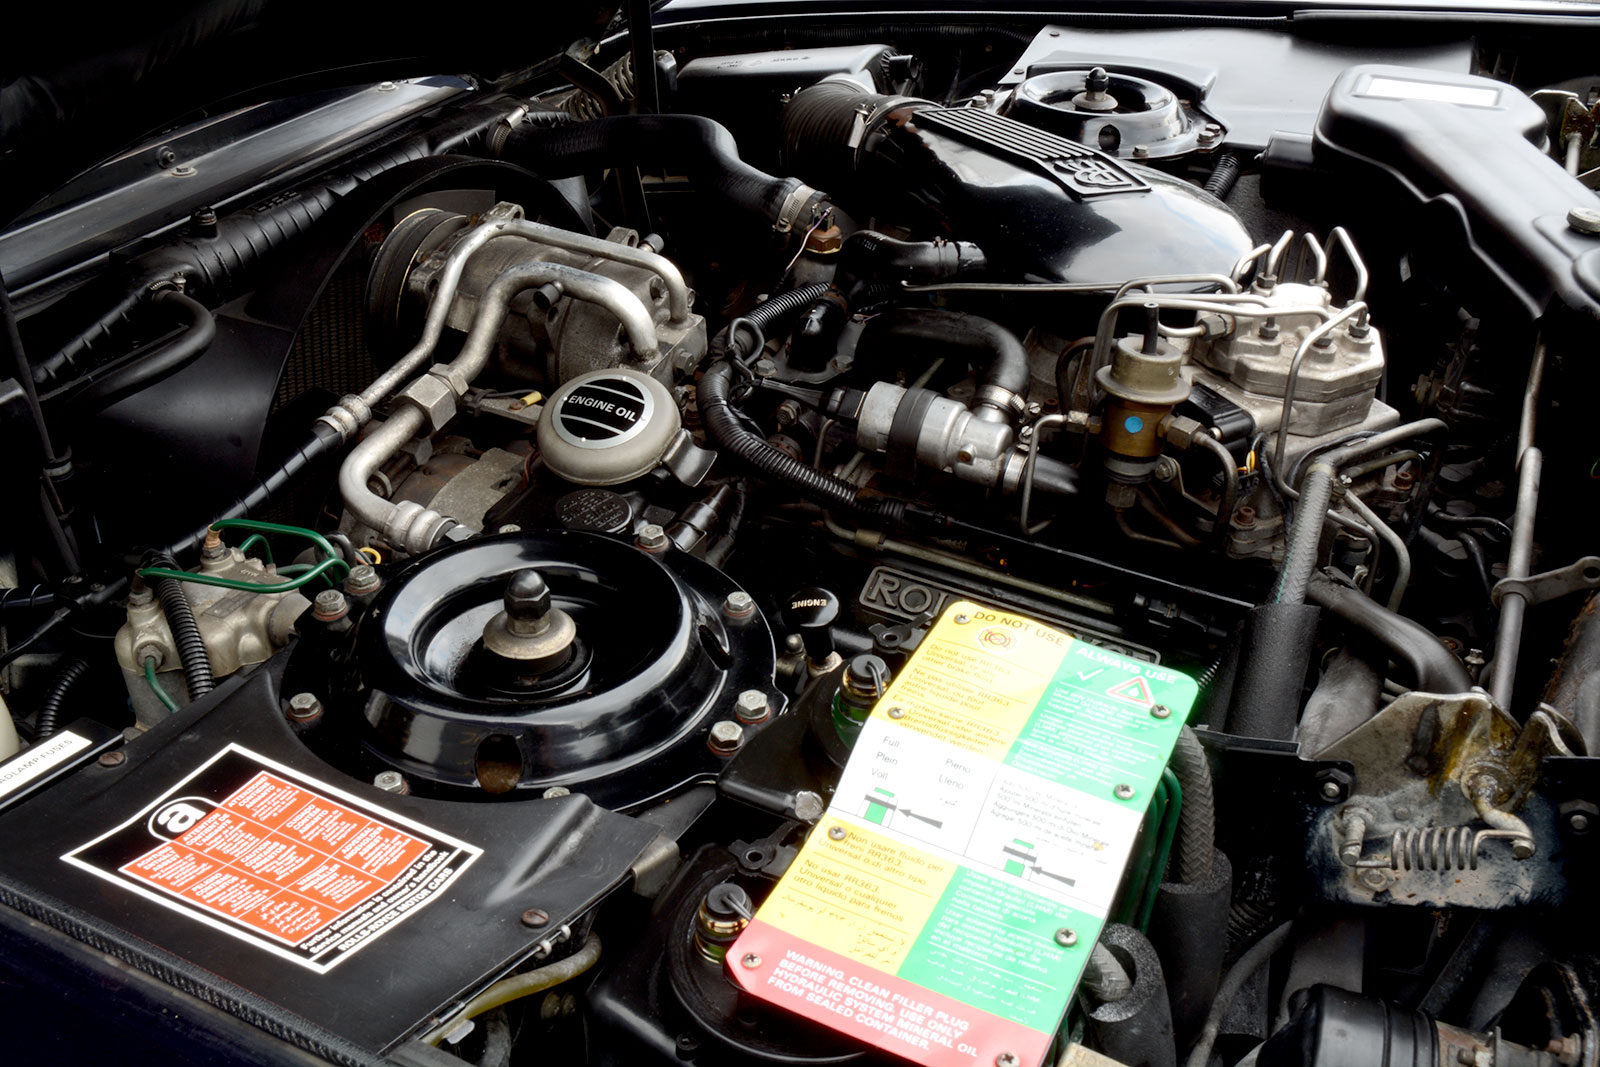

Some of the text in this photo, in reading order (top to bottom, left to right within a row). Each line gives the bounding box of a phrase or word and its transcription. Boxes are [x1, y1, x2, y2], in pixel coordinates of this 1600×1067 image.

[568, 395, 636, 422] ENGINE OIL
[792, 598, 827, 610] ENGINE
[974, 611, 1065, 646] DO NOT USE
[1076, 647, 1177, 684] ALWAYS USE
[40, 739, 73, 759] FUSES
[875, 750, 899, 766] Plein
[882, 734, 900, 748] Full
[869, 766, 889, 780] Voll
[944, 757, 971, 774] Pieno
[181, 811, 222, 841] ATTENTION
[286, 804, 316, 828] CUIDADO
[238, 839, 273, 862] CAUTION
[243, 840, 281, 867] CONTAINS
[817, 838, 861, 861] Universal
[883, 864, 906, 878] altro
[848, 831, 944, 873] Non usare fluido per
[804, 858, 819, 869] No
[820, 865, 841, 879] usar
[299, 927, 333, 949] Further
[327, 899, 376, 930] information
[370, 894, 384, 902] is
[379, 867, 418, 897] contained
[412, 860, 427, 869] in
[420, 849, 438, 862] the
[308, 931, 342, 953] Service
[338, 910, 375, 934] manuals
[369, 901, 389, 913] and
[411, 850, 450, 882] handbook
[792, 874, 813, 887] otro
[848, 896, 870, 911] para
[799, 866, 843, 888] Universal
[853, 889, 898, 911] cualquier
[336, 909, 400, 951] ROLLS-ROYCE
[395, 888, 433, 912] MOTOR
[425, 866, 454, 890] CARS
[767, 975, 931, 1051] FROM SEALED CONTAINER.
[773, 966, 978, 1056] HYDRAULIC SYSTEM MINERAL OIL
[778, 957, 827, 984] BEFORE
[898, 1006, 926, 1025] USE
[925, 1018, 963, 1039] ONLY
[847, 975, 890, 999] CLEAN
[891, 993, 934, 1016] FILLER
[933, 1010, 970, 1031] PLUG
